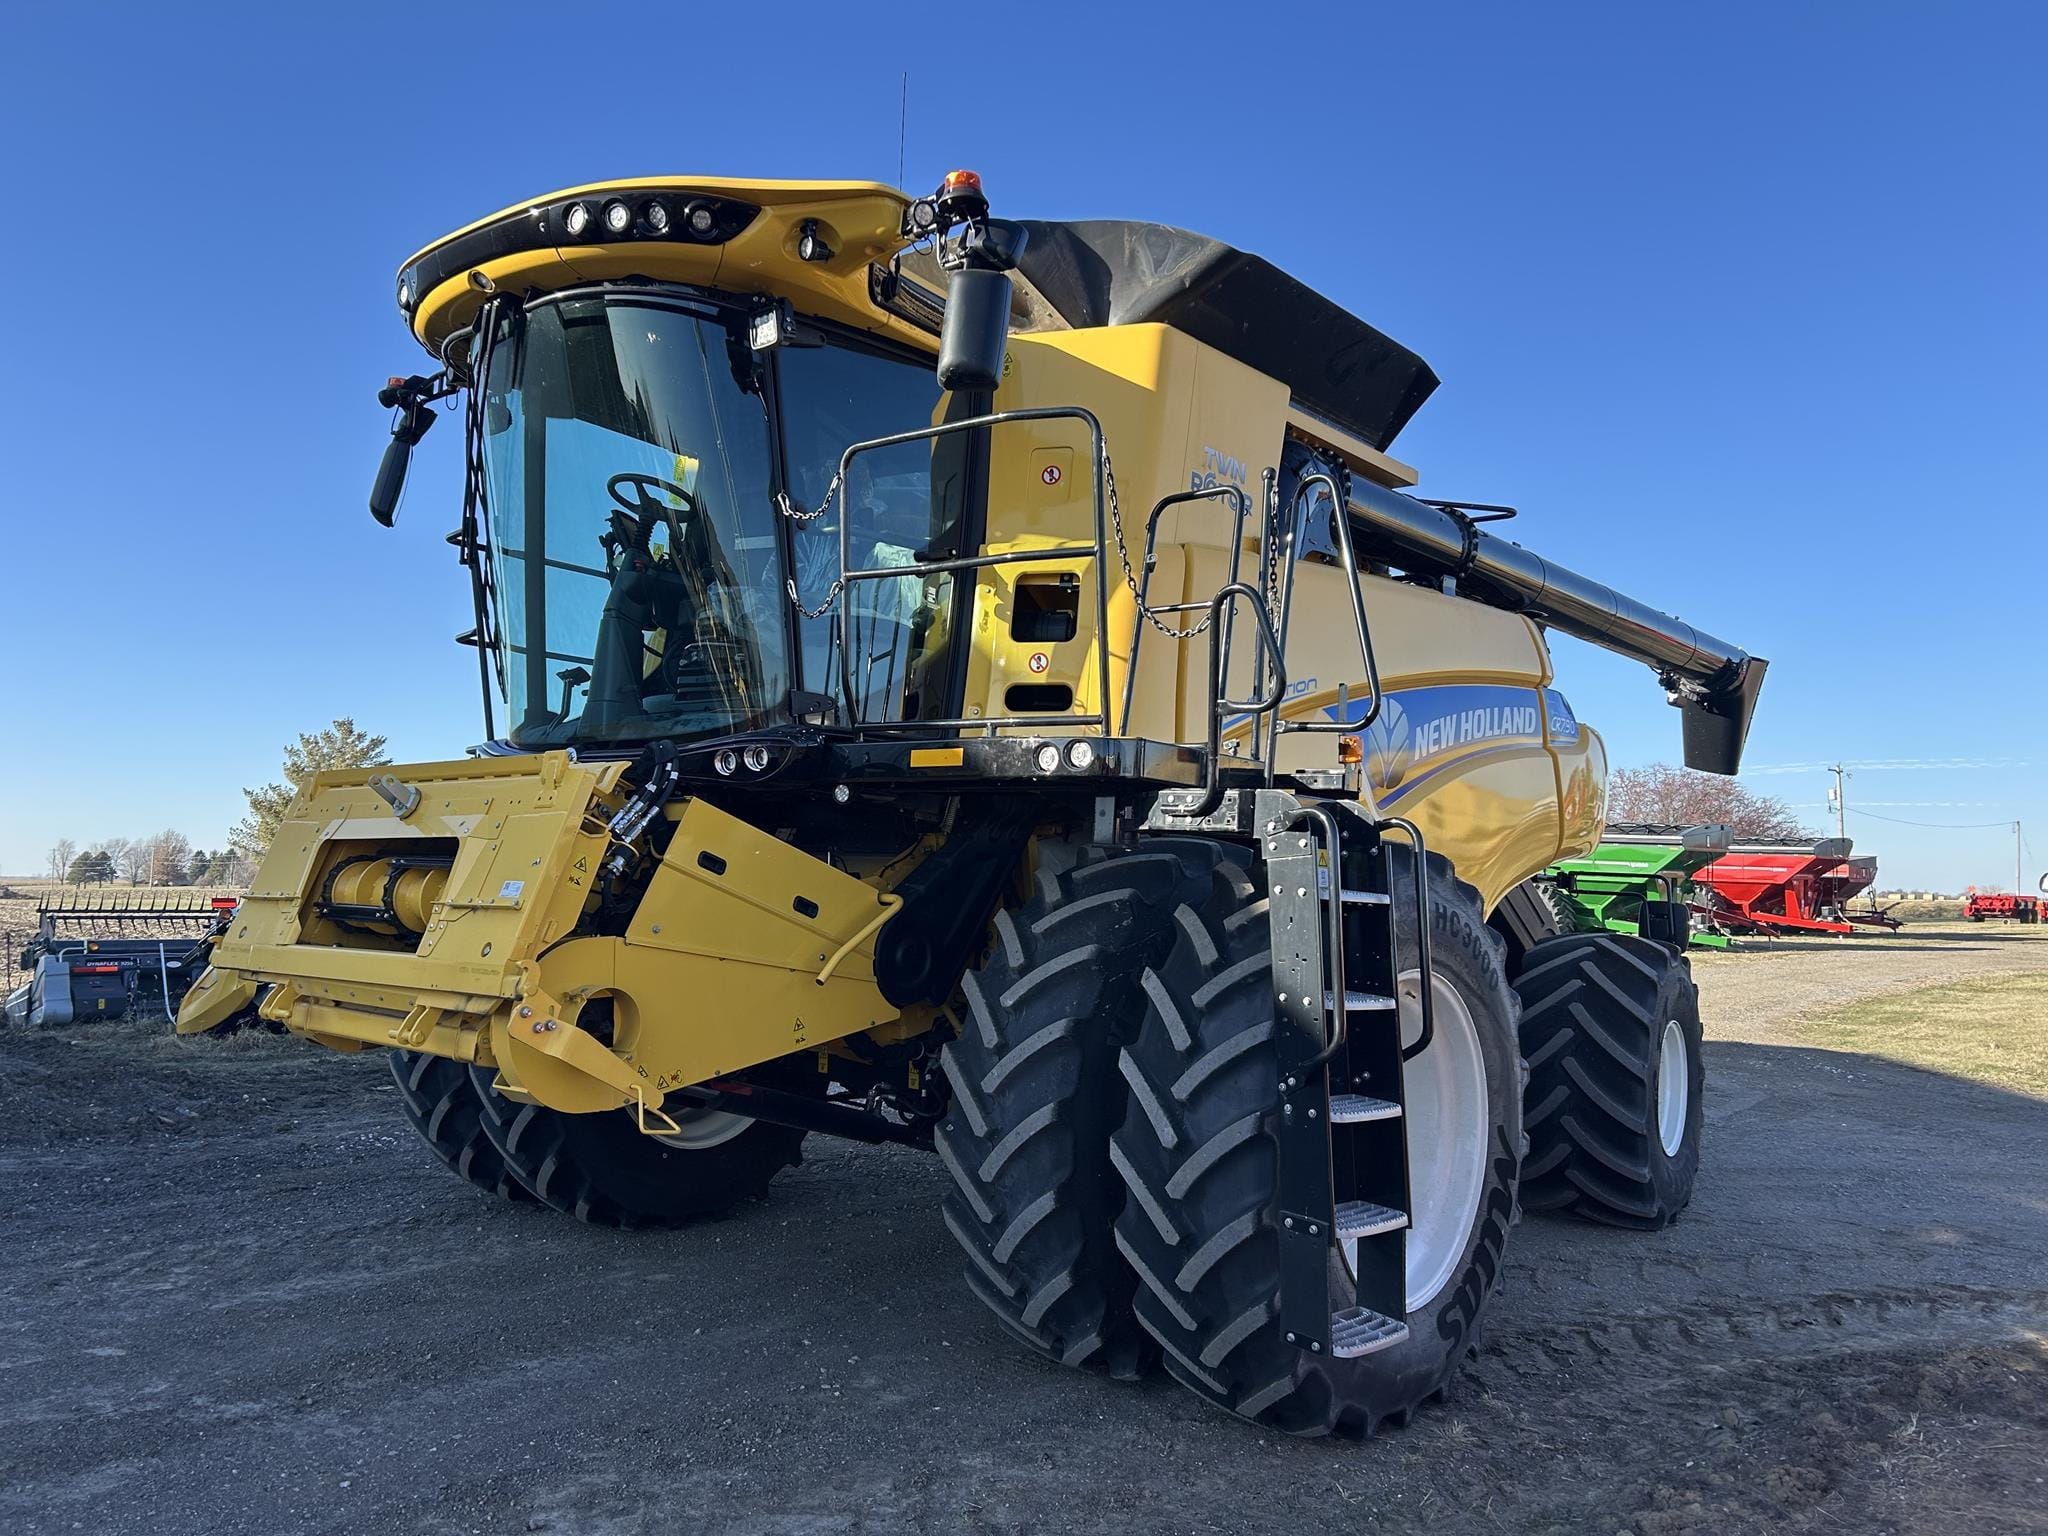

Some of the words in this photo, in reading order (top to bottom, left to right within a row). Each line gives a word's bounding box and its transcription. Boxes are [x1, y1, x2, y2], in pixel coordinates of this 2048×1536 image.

[1204, 446, 1246, 484] TWIN
[1414, 714, 1457, 760] NEW
[1460, 706, 1536, 743] HOLLAND
